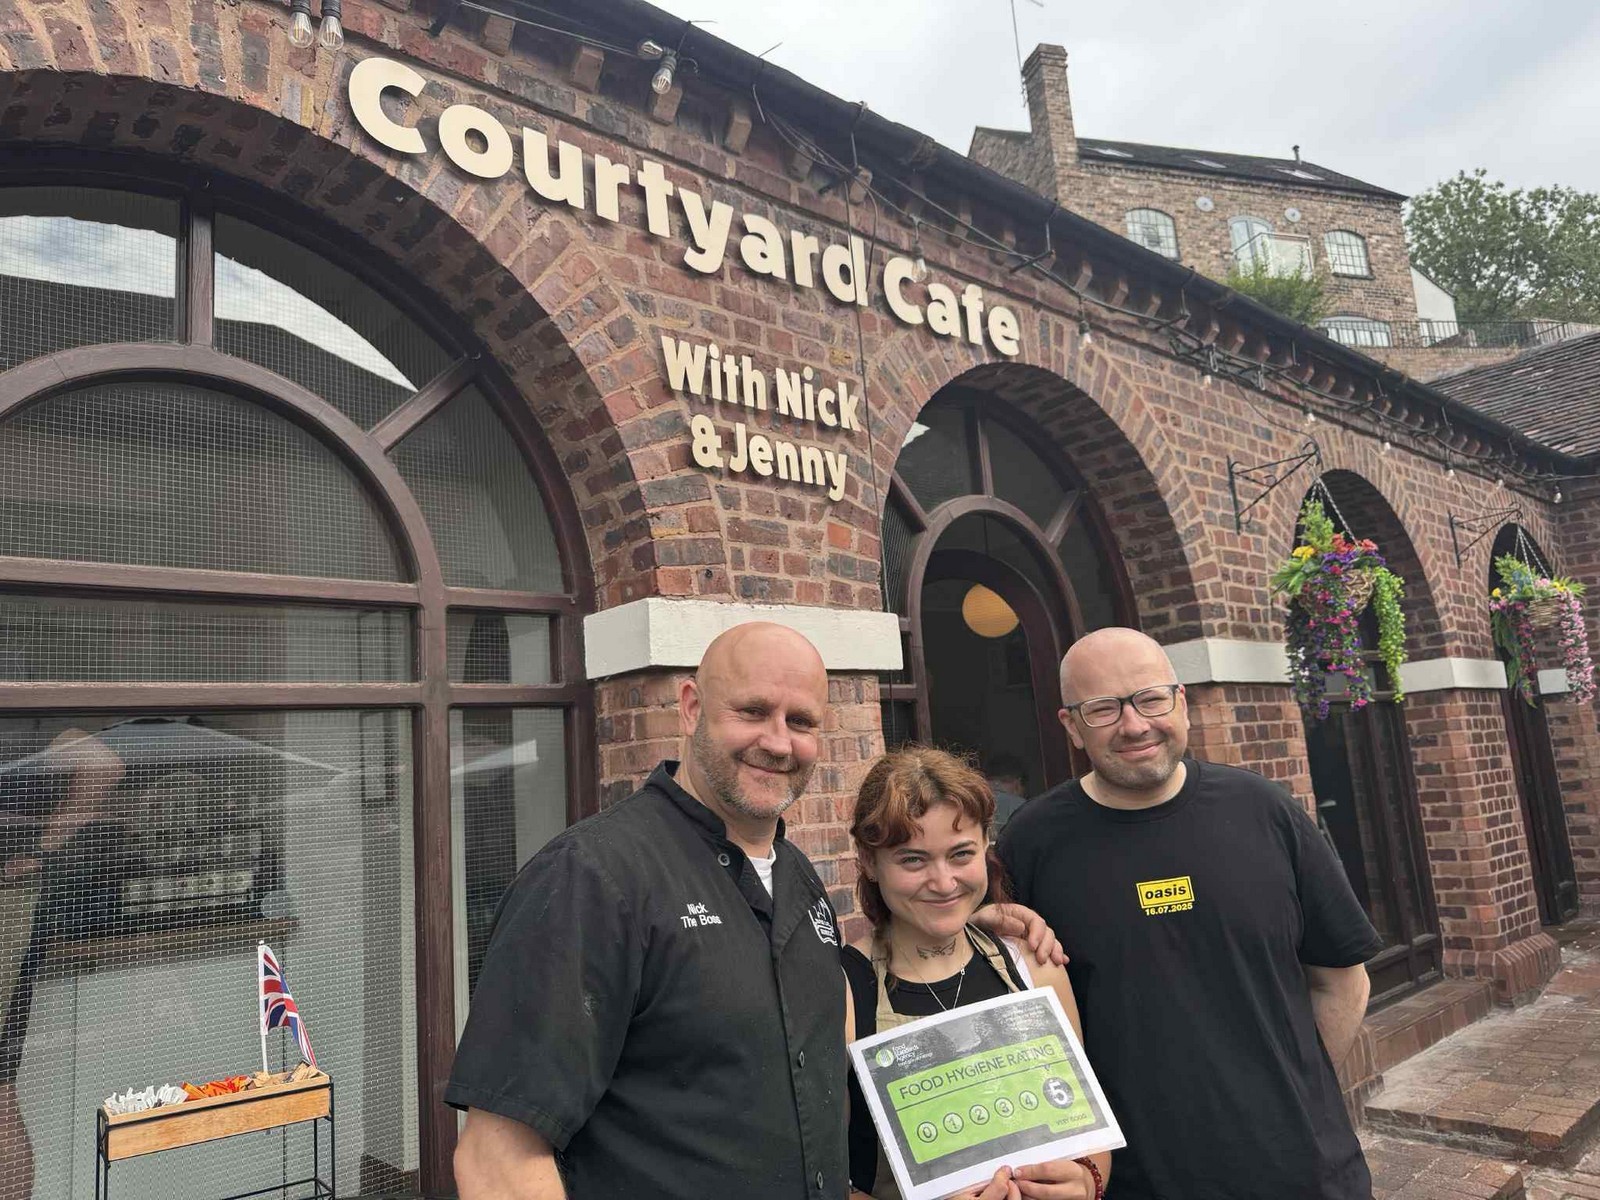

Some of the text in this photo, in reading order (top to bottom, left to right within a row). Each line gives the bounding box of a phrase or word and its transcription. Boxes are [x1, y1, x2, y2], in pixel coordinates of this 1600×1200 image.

[348, 56, 1021, 357] Courtyard Cafe
[660, 335, 862, 433] With Nick
[691, 416, 848, 503] & Jenny
[686, 902, 709, 915] Nick
[1144, 902, 1193, 916] 16.07.2025
[1145, 884, 1187, 900] oasis
[680, 914, 723, 928] The Boss
[898, 1075, 944, 1100] FOOD
[945, 1056, 1008, 1084] HYGIENE
[1006, 1043, 1056, 1066] RATING
[922, 1126, 933, 1139] 0
[973, 1108, 985, 1122] 2
[999, 1101, 1010, 1115] 3
[1024, 1094, 1034, 1108] 4
[1048, 1080, 1069, 1106] 5
